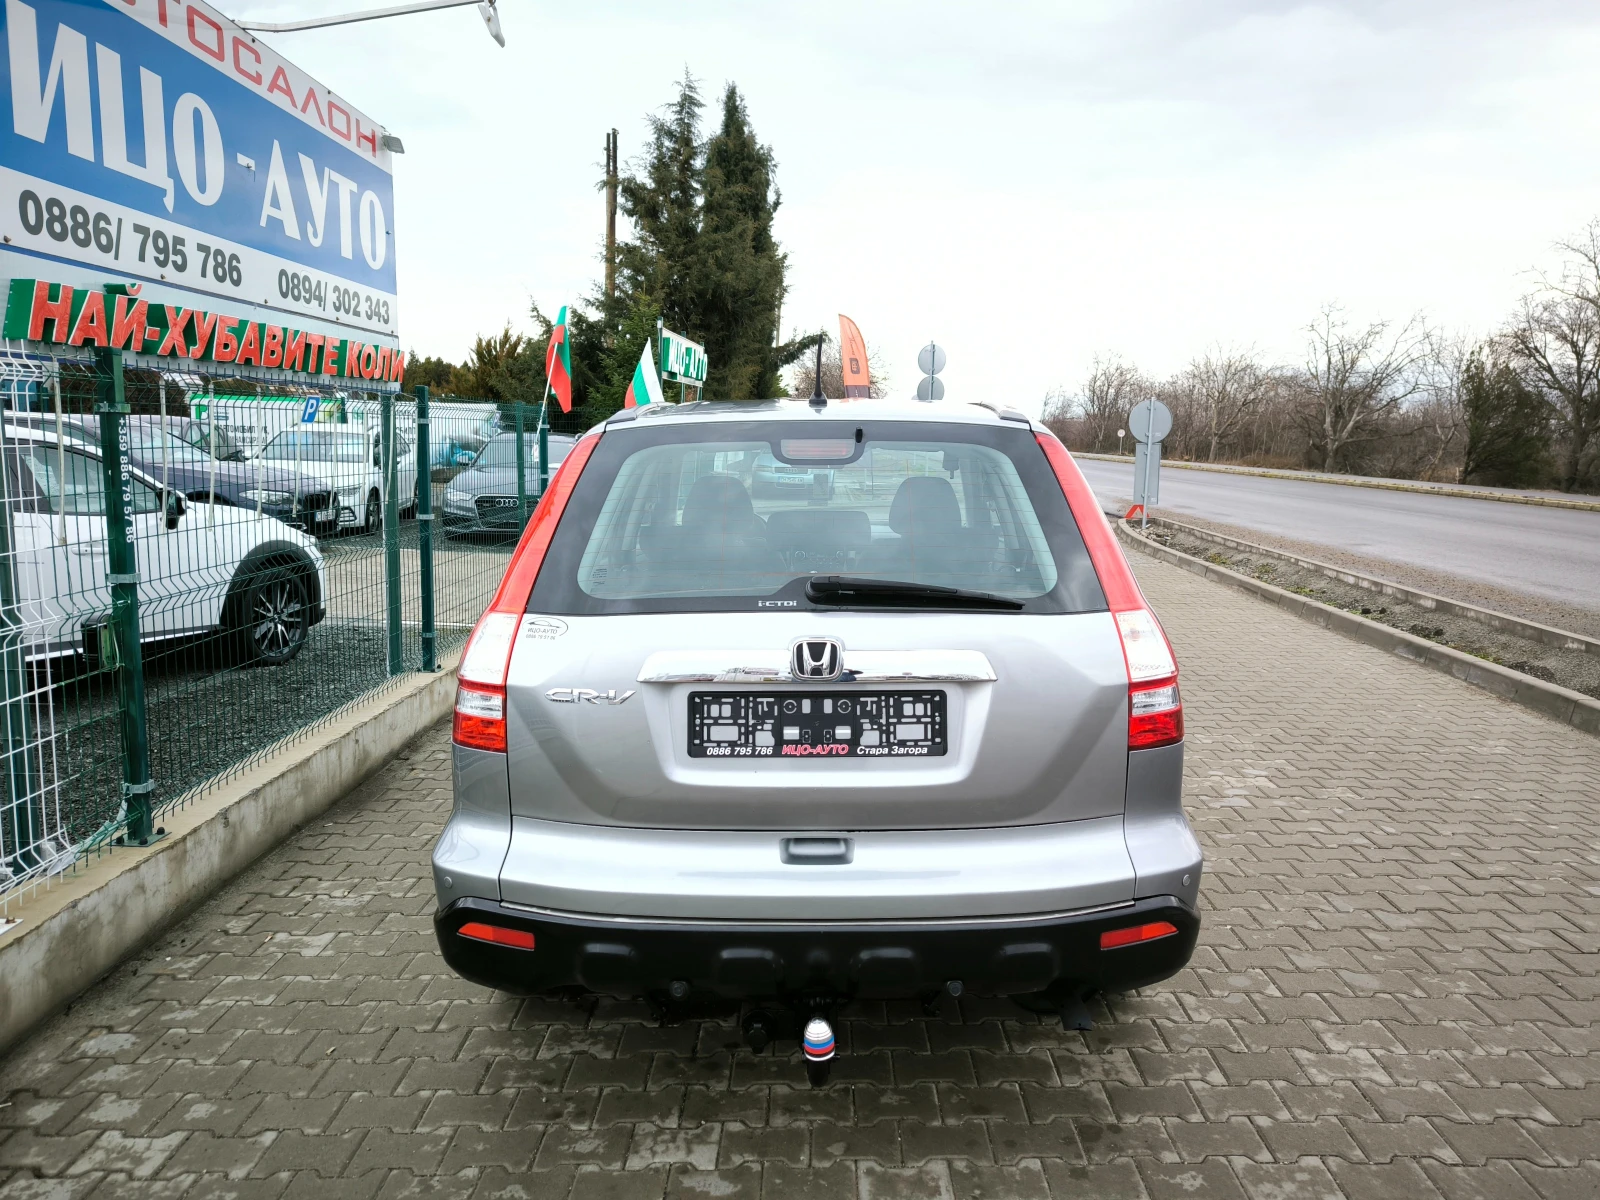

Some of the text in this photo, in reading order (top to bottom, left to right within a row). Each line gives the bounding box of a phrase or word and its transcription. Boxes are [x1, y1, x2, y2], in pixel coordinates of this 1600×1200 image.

[121, 0, 377, 158] ТОСАЛОН
[18, 189, 243, 288] 0886/ 795 786
[27, 278, 405, 384] НАЙ-ХУБАВИТЕ КОЛИ
[278, 268, 390, 325] 0894/ 302 343
[118, 417, 135, 543] +359 886 79 57 86
[544, 687, 636, 705] CR-V
[706, 744, 928, 756] 0886 795 786 ИЦО-АУТО Стара Загора
